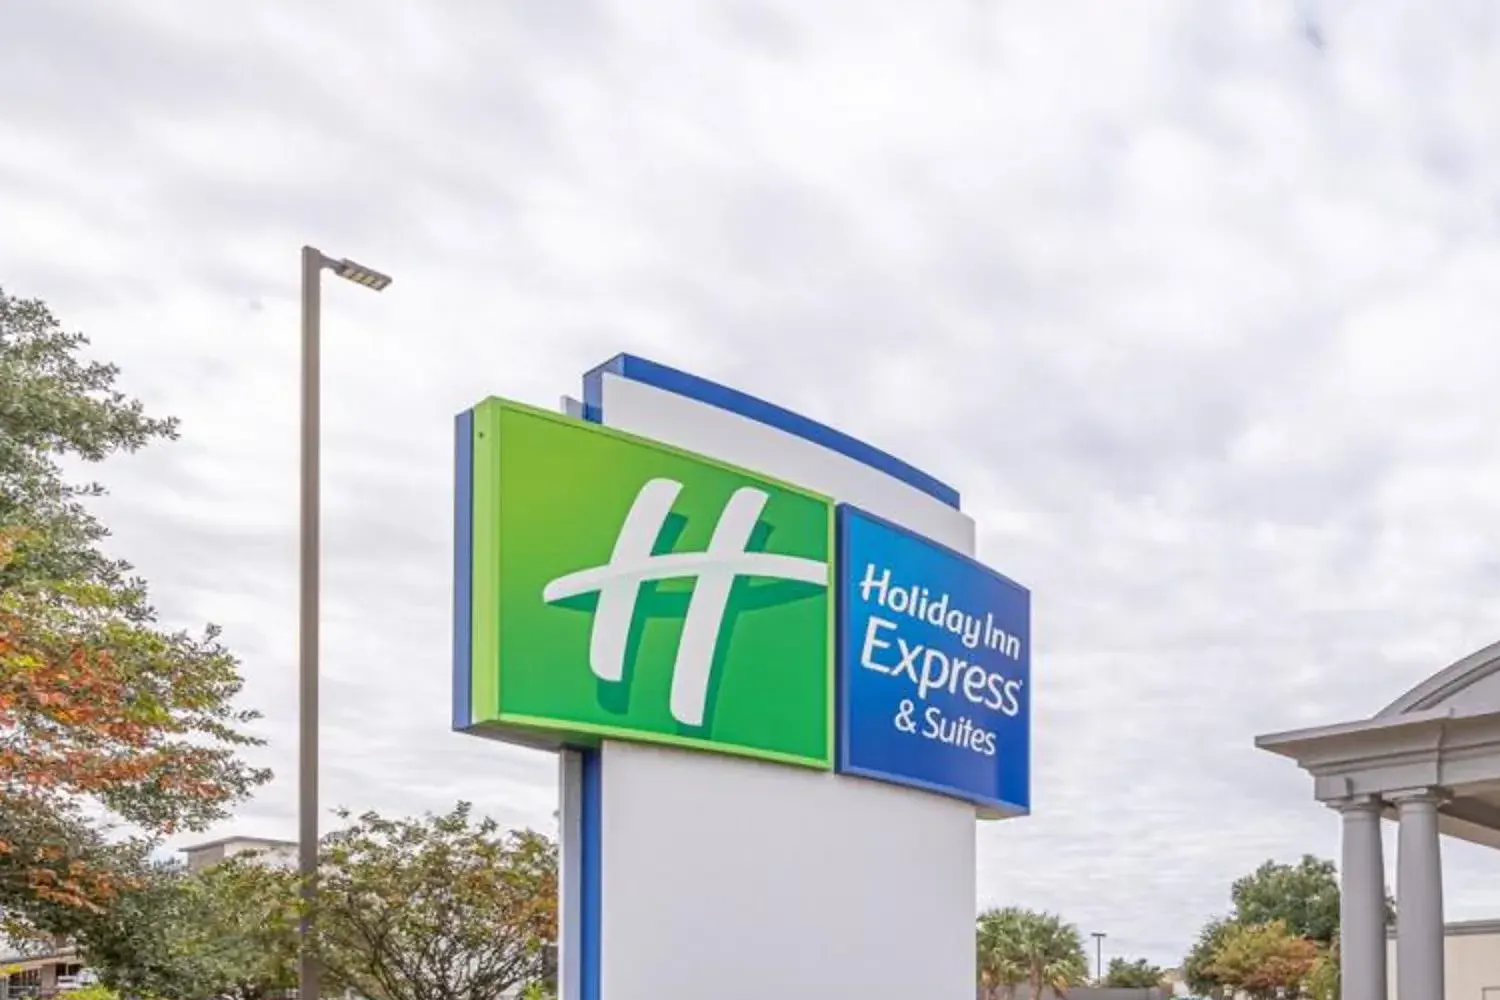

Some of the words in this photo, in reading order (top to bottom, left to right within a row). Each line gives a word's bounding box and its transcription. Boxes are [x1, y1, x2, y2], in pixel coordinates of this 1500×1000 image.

[859, 563, 981, 649] Holiday
[984, 612, 1021, 661] Inn
[860, 615, 1023, 717] Express
[894, 699, 917, 735] &
[922, 707, 997, 756] Suites
